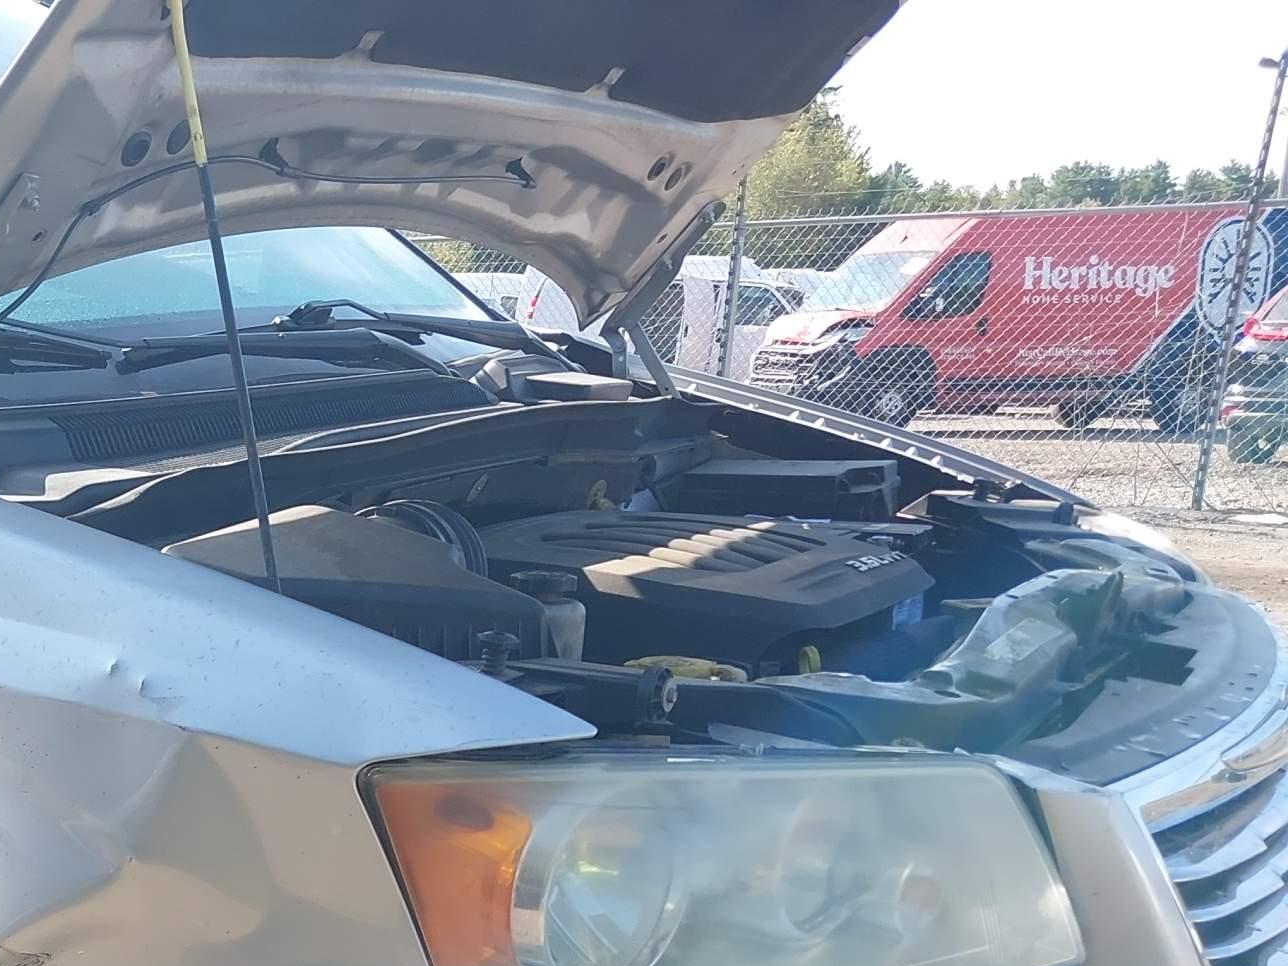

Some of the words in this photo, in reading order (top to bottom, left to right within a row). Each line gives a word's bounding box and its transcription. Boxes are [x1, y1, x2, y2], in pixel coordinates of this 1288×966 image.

[1022, 255, 1176, 297] Heritage
[1022, 295, 1059, 305] HOME
[1064, 294, 1122, 304] SERVICE
